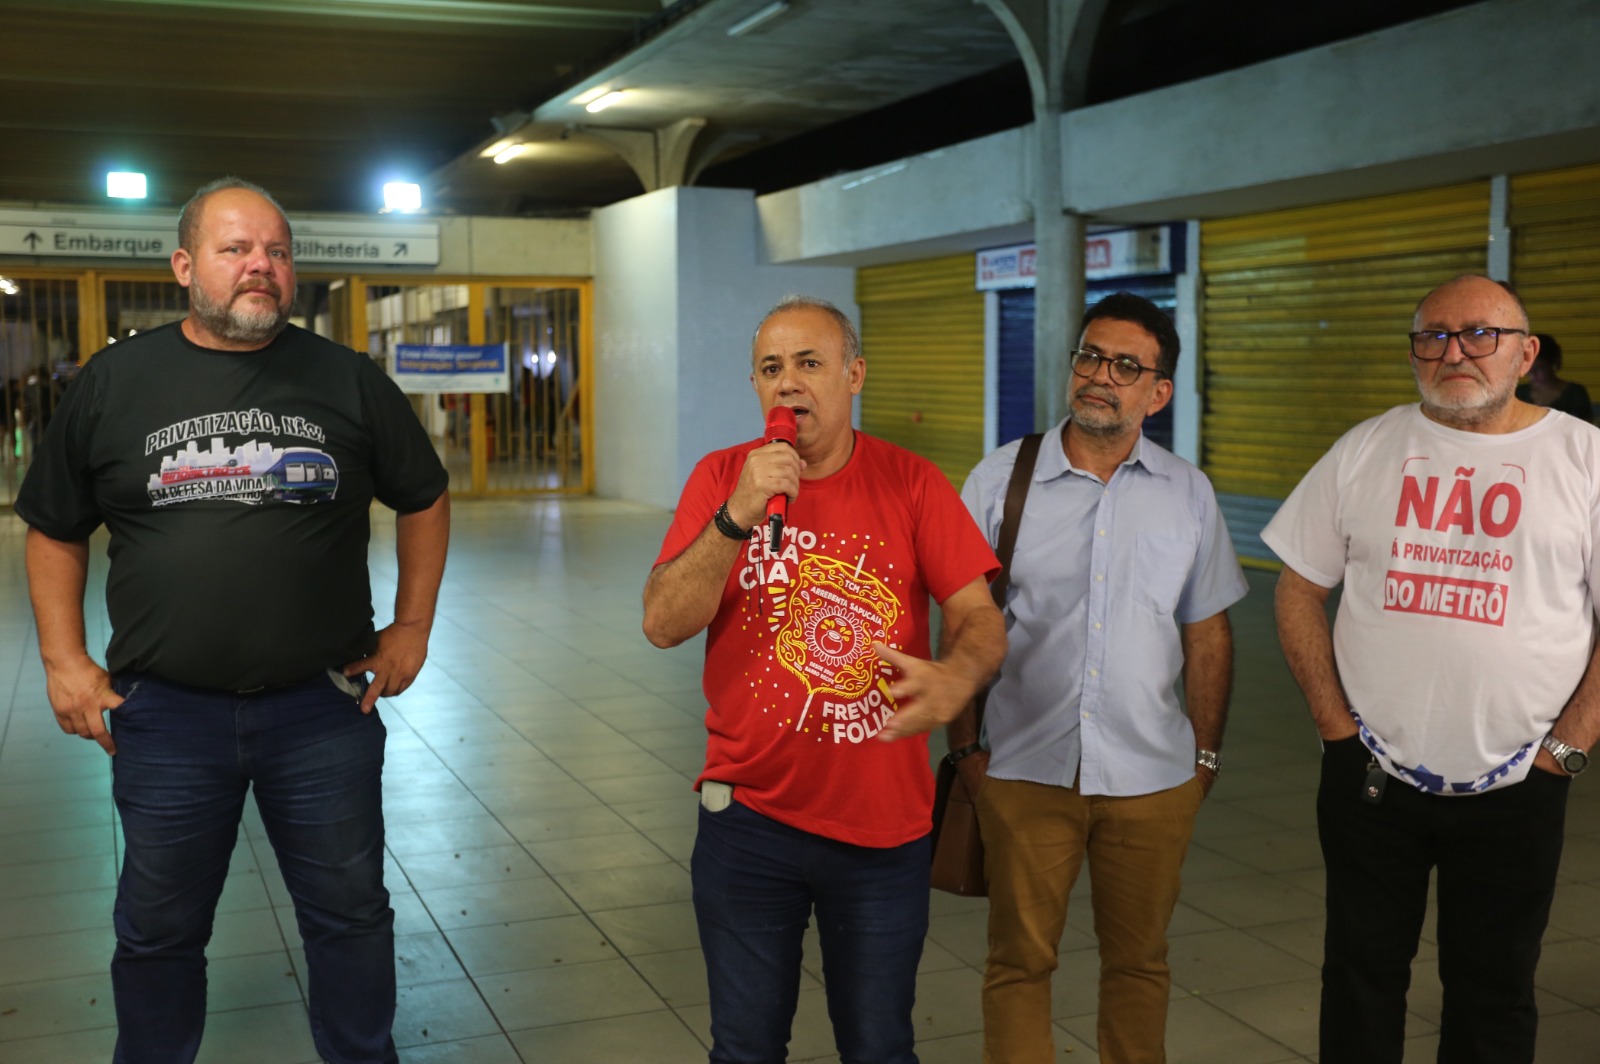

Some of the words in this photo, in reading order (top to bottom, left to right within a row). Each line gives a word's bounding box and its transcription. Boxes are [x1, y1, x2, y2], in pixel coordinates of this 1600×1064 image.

[53, 232, 163, 257] Embarque
[292, 240, 380, 258] Bilheteria
[145, 408, 280, 456] PRIVATIZAÇÃO,
[149, 488, 169, 501] EM
[169, 480, 215, 499] DEFESA
[216, 480, 233, 494] DA
[233, 478, 264, 492] VIDA
[1395, 466, 1522, 538] NÃO
[748, 543, 799, 565] CRA
[1403, 542, 1513, 573] PRIVATIZAÇÃO
[845, 580, 860, 593] TCM
[1385, 577, 1415, 608] DO
[1420, 584, 1504, 621] METRÔ
[849, 602, 882, 625] SAPUCAIA
[822, 689, 881, 720] FREVO
[821, 722, 830, 732] E
